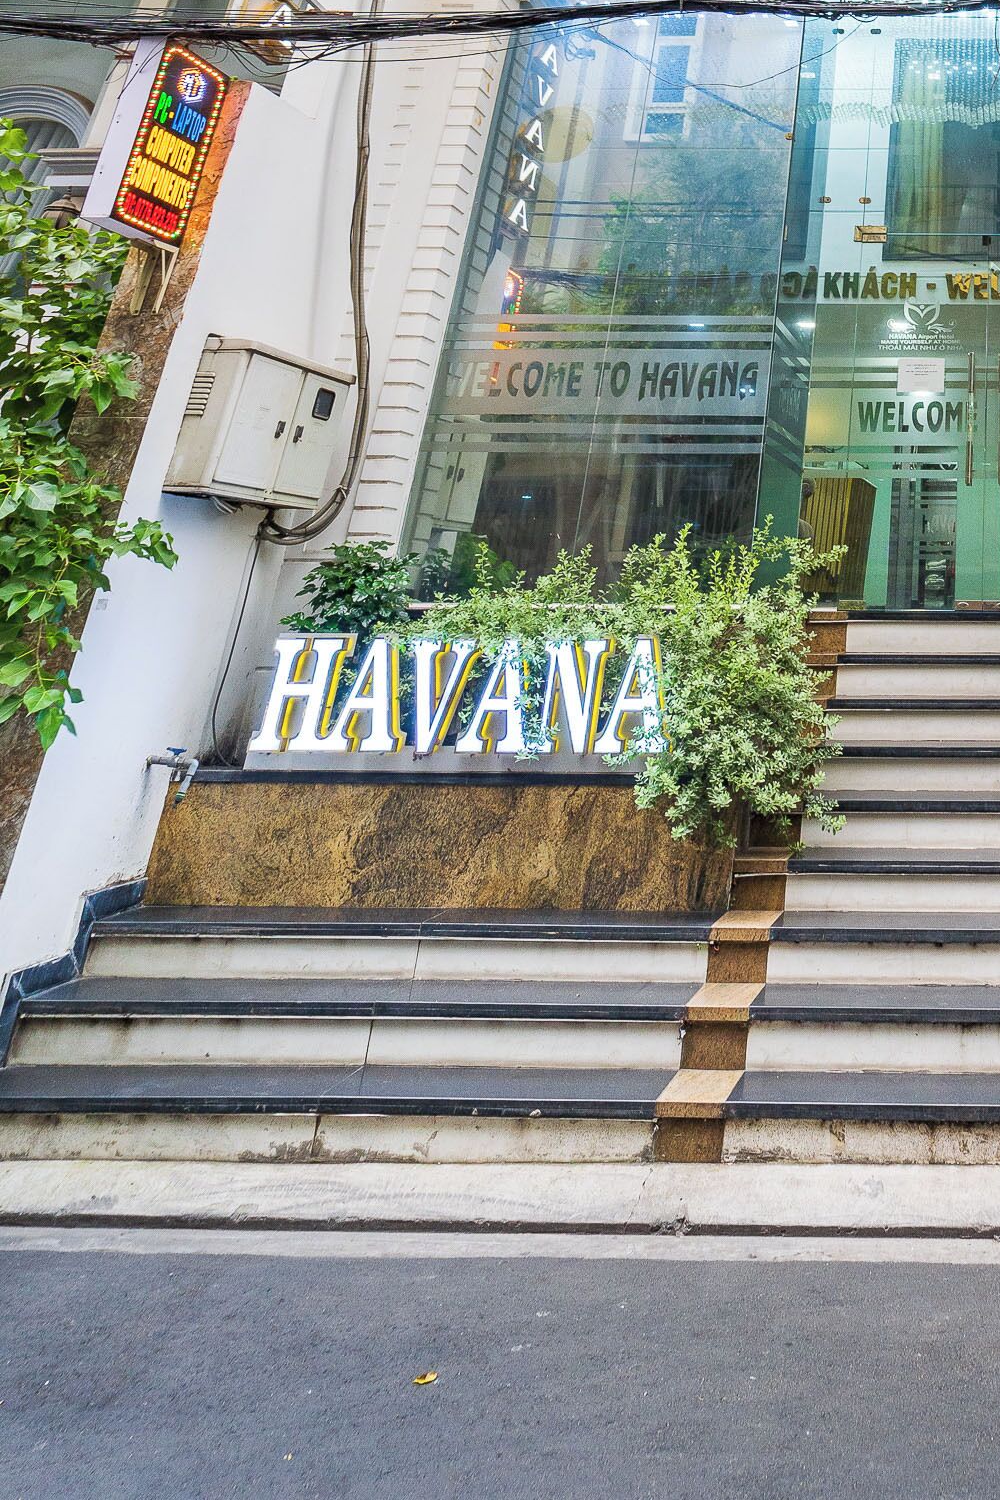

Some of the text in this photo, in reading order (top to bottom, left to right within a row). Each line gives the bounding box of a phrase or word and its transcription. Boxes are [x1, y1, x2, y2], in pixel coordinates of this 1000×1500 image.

[154, 92, 173, 125] PC
[172, 102, 207, 143] LAPTOP
[146, 125, 196, 175] COMPUTER
[130, 155, 191, 210] COMPONENTS
[823, 266, 917, 300] KHÁCH
[918, 333, 938, 341] Airport
[445, 361, 759, 402] WELCOME TO HAVANA
[249, 636, 672, 755] HAVANA
